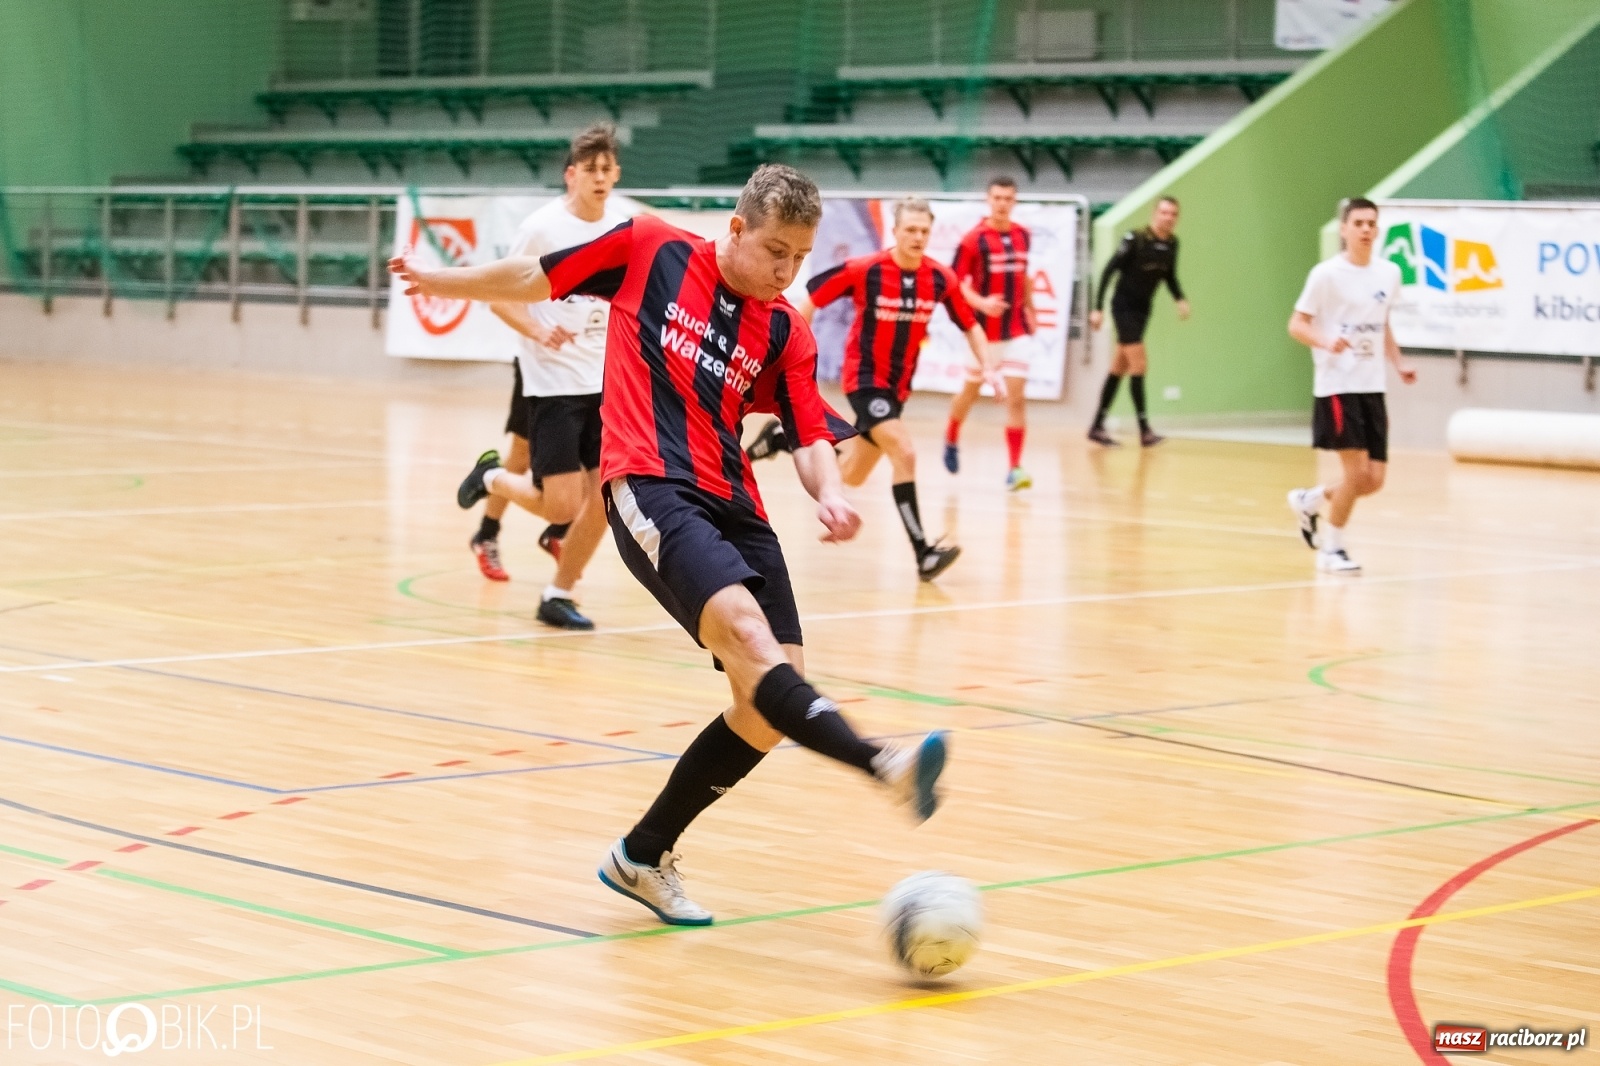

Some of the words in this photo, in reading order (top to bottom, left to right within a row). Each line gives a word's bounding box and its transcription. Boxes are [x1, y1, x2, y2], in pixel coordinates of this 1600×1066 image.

[665, 302, 715, 342] Stuck
[718, 335, 727, 353] &
[731, 344, 762, 378] Putz
[1534, 295, 1600, 322] kibic
[660, 324, 752, 395] Warzecha
